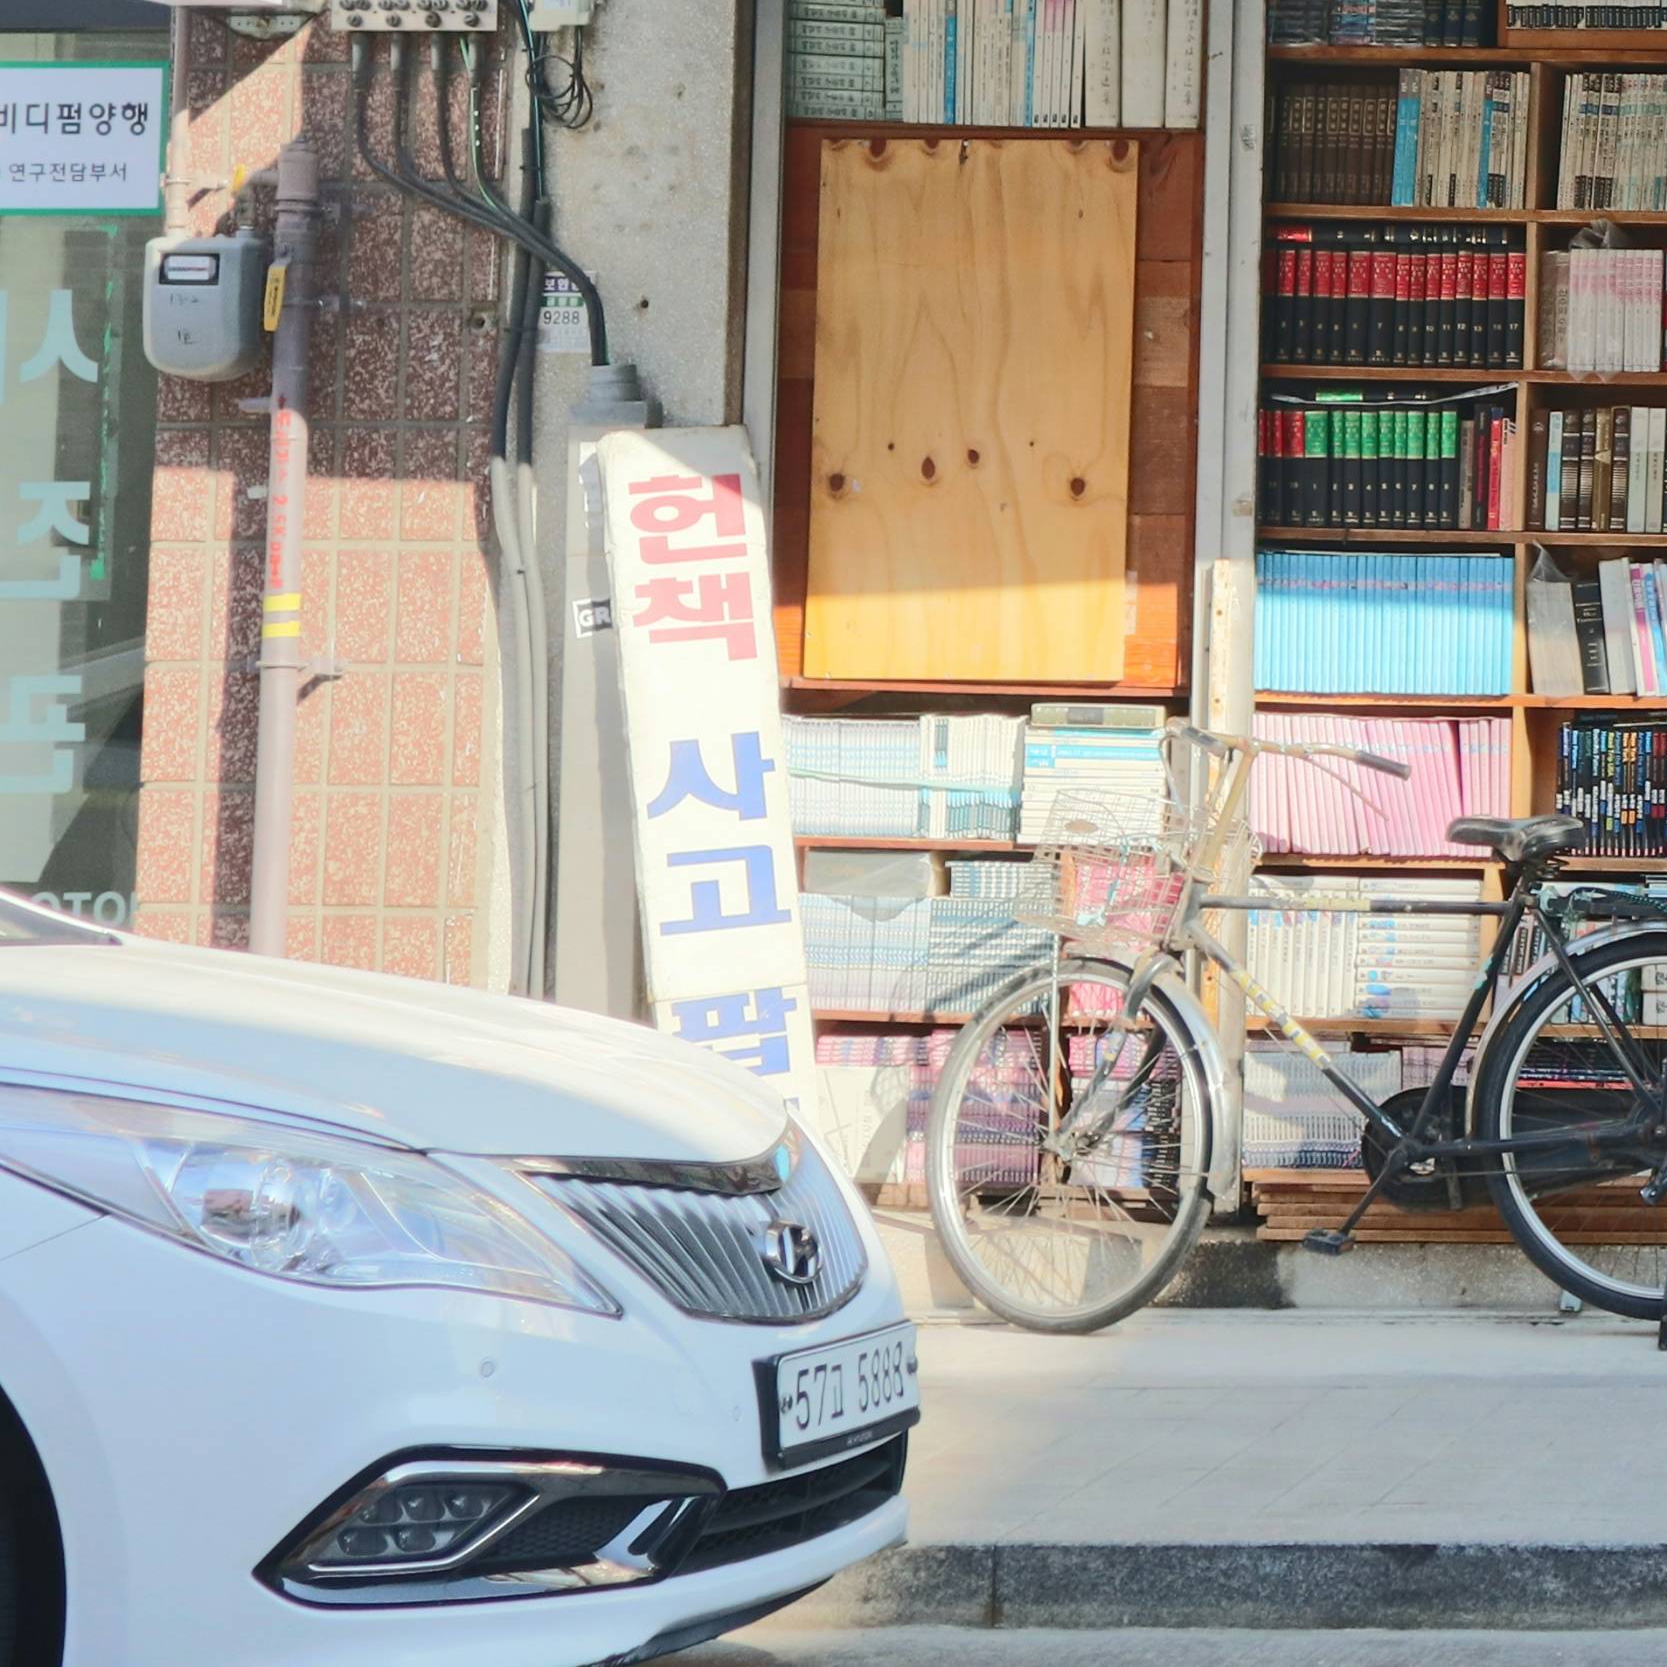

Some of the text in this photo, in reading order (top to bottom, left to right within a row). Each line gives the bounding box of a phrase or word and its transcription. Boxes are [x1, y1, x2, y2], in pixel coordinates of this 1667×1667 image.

[8, 162, 127, 183] 연구전담부서
[543, 310, 580, 325] 9288
[627, 473, 759, 661] 헌책
[795, 1340, 905, 1431] 57고 5888
